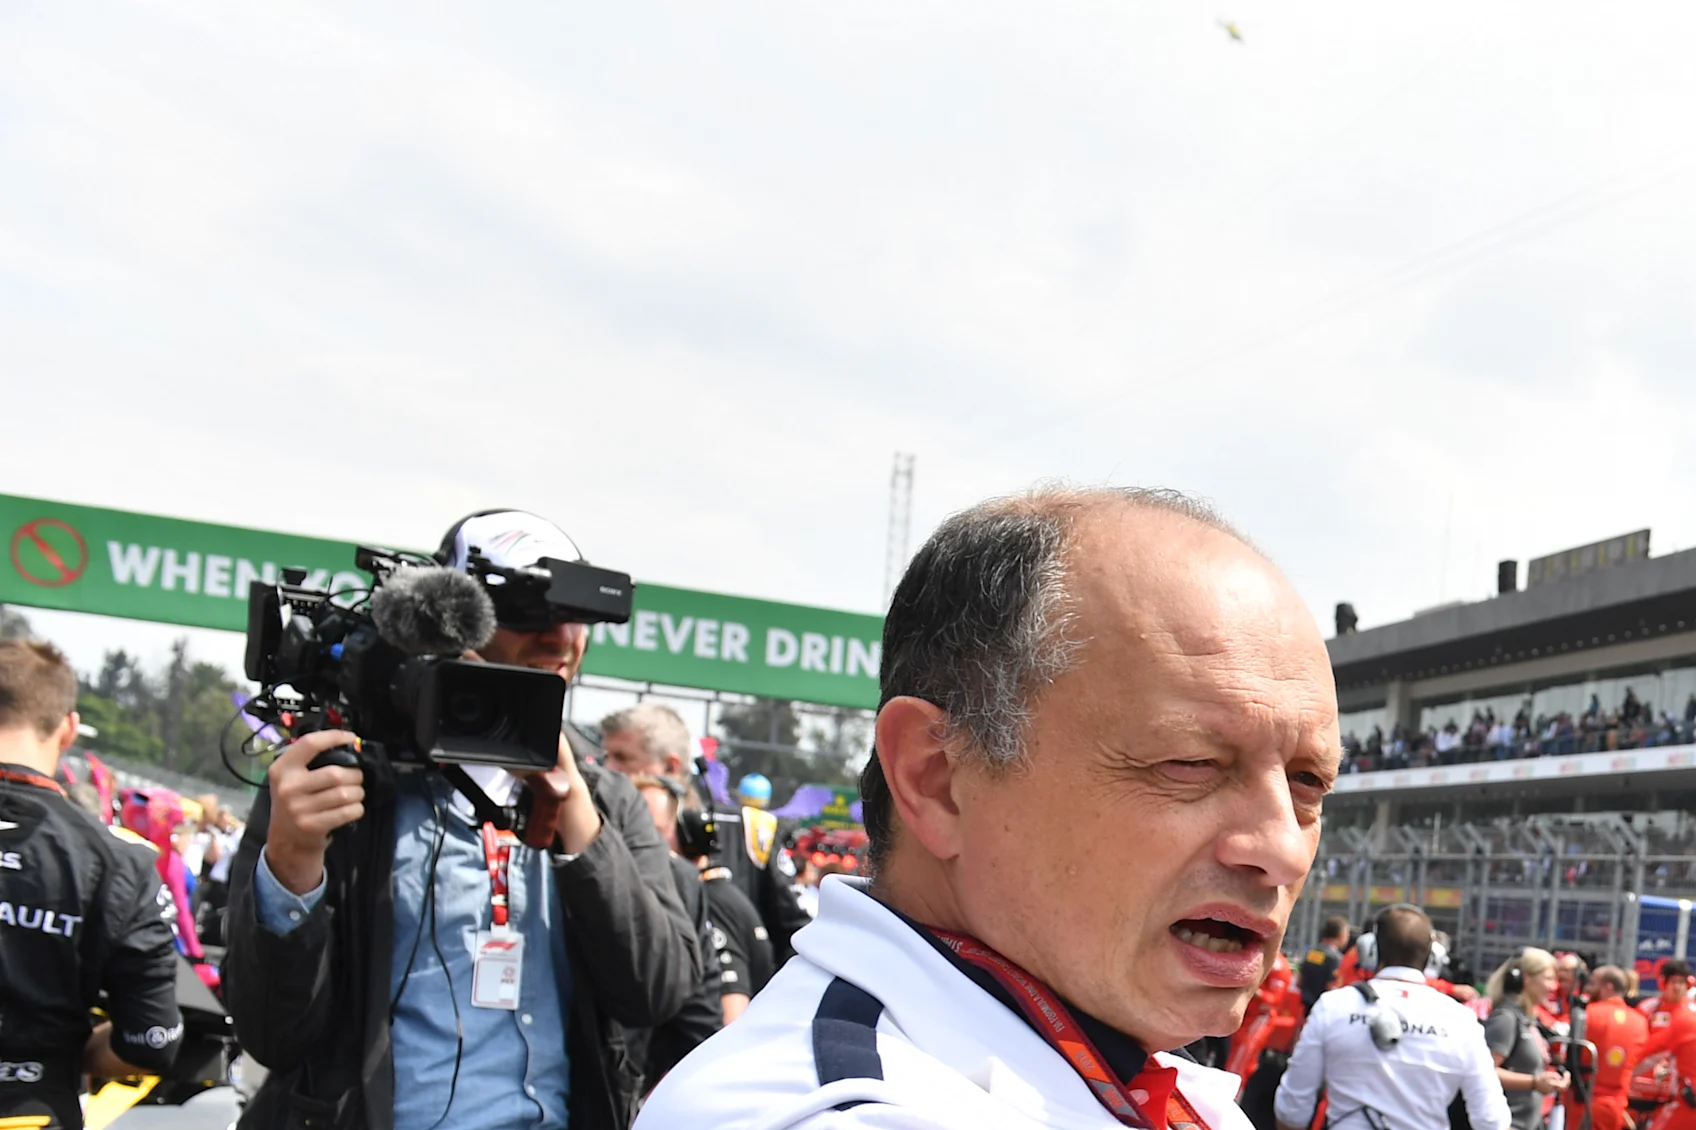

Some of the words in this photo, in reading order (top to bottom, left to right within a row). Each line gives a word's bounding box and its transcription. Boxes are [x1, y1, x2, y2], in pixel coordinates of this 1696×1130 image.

[106, 540, 276, 600] WHEN
[592, 610, 750, 664] NEVER
[765, 627, 880, 679] DRIN
